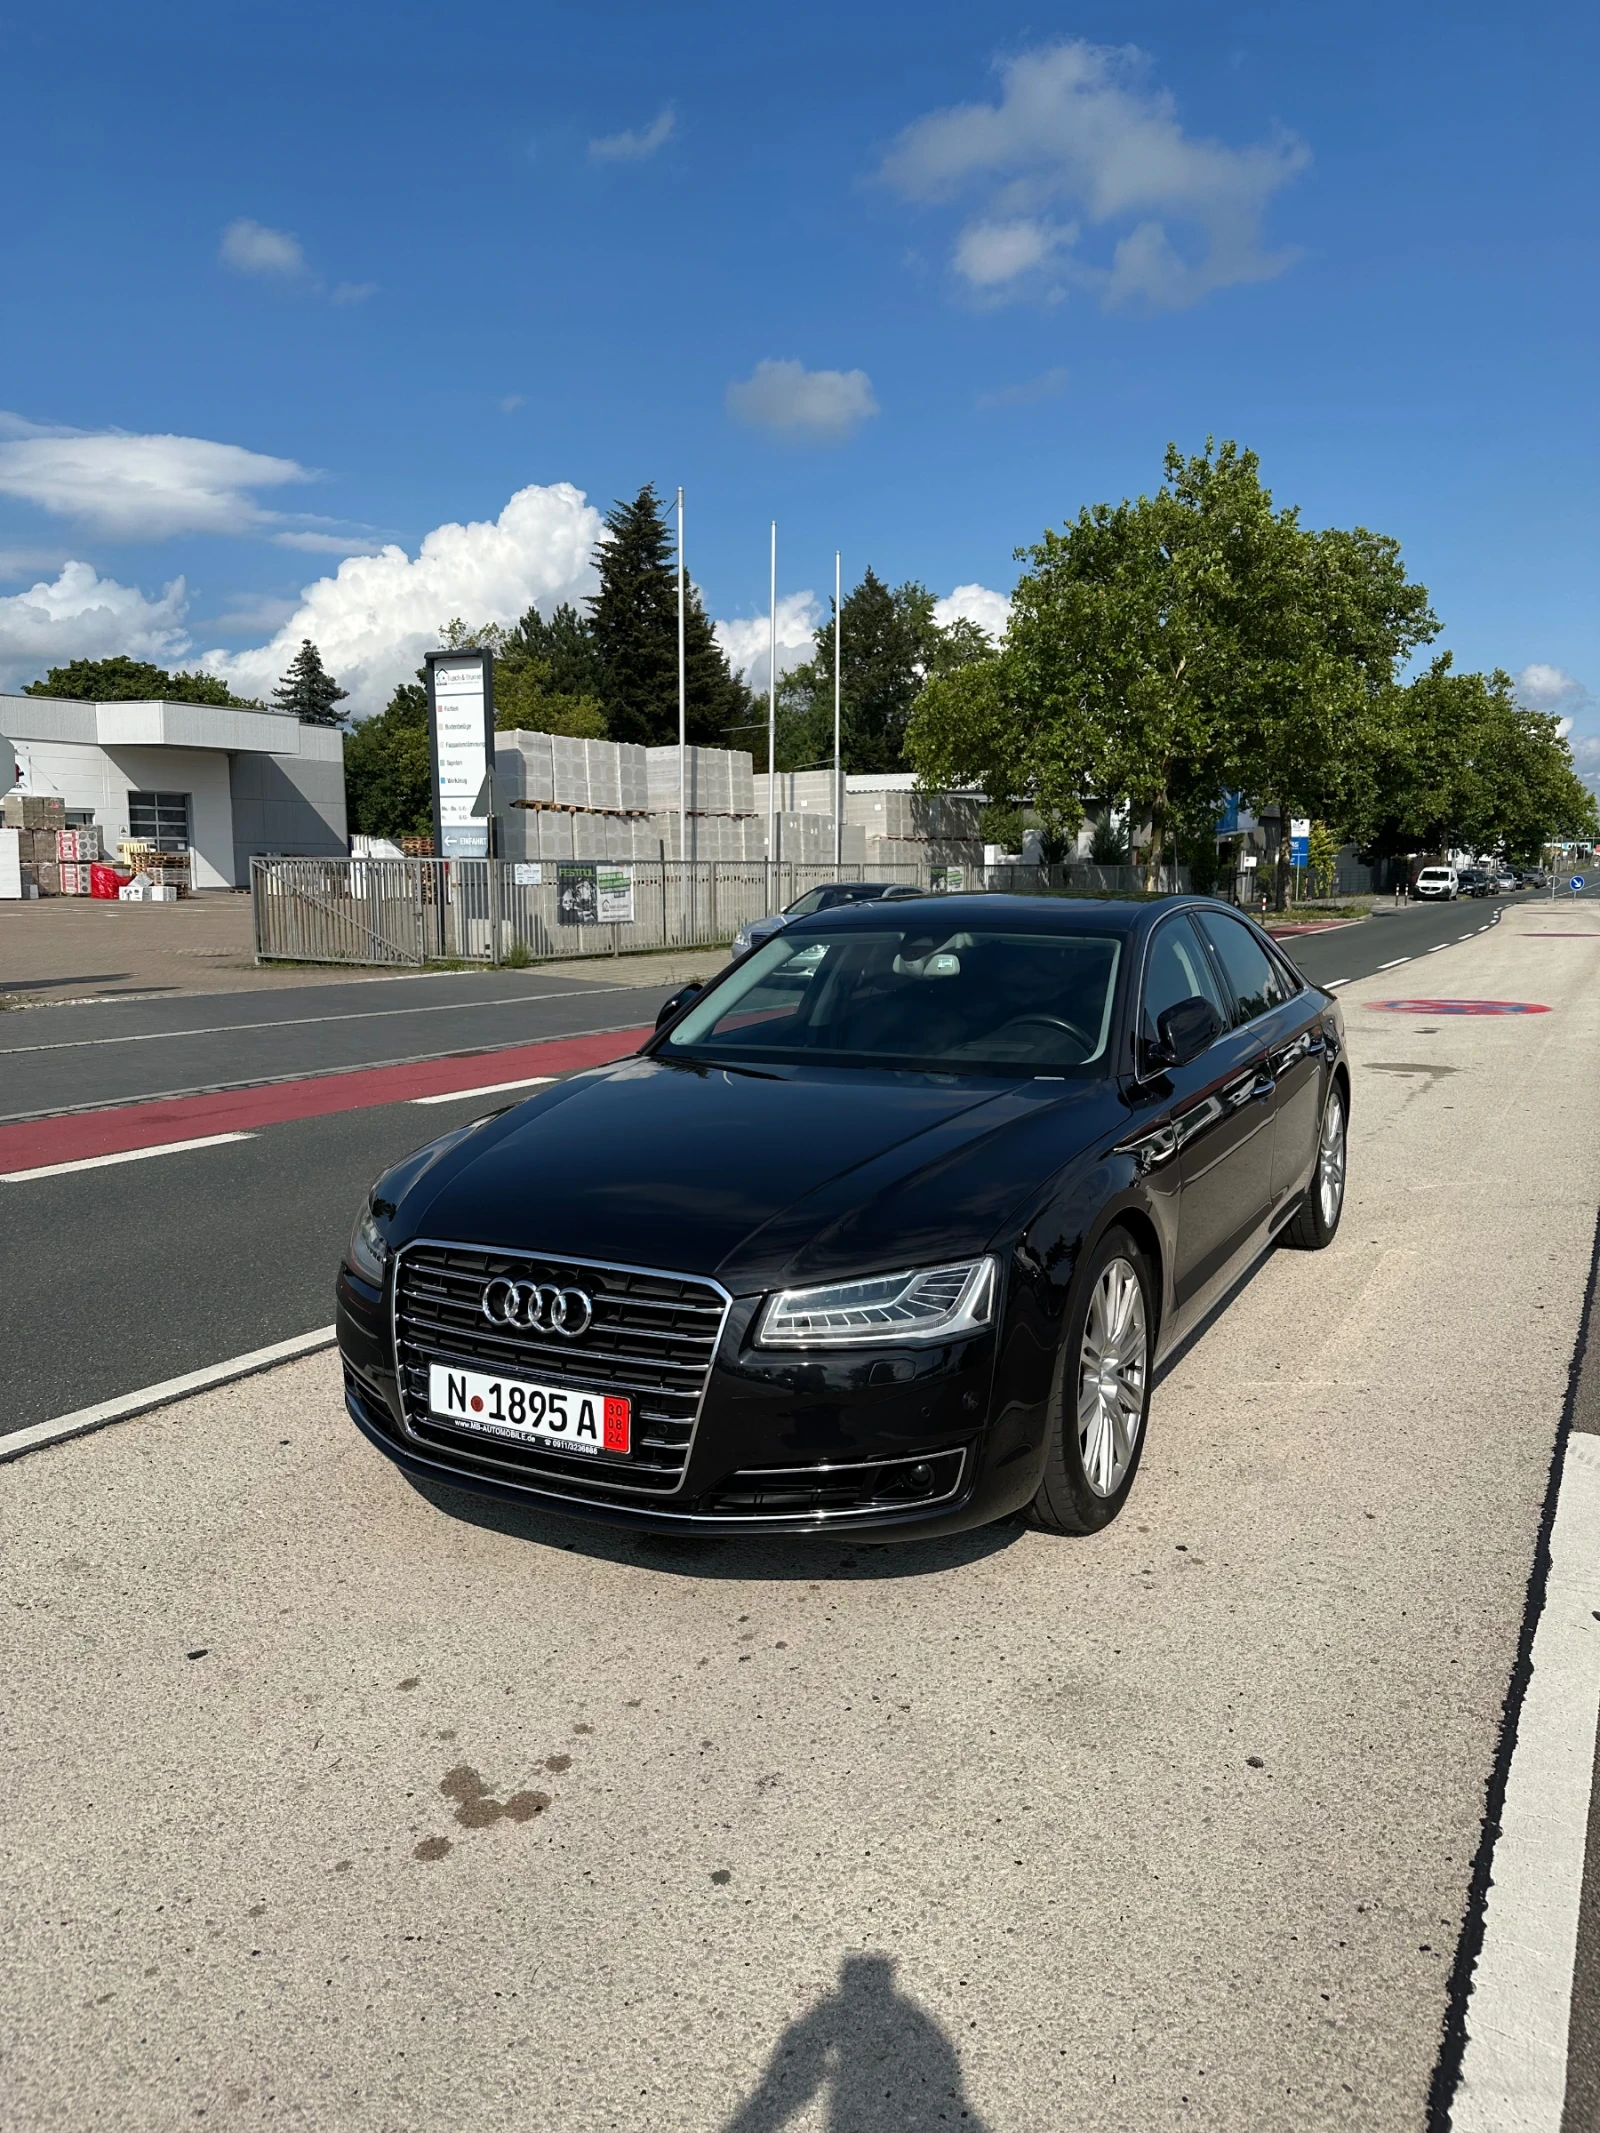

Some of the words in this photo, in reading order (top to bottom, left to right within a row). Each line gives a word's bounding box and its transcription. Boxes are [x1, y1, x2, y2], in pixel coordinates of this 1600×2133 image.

[459, 837, 488, 846] EINFAHRT
[558, 868, 596, 877] FESTOOL
[448, 1373, 466, 1412] N
[488, 1382, 568, 1432] 1895
[577, 1399, 597, 1440] A
[608, 1404, 622, 1416] 30
[608, 1417, 622, 1430] 08
[454, 1420, 535, 1442] www.MB-AUTOMOBILE.de
[608, 1431, 622, 1444] 24
